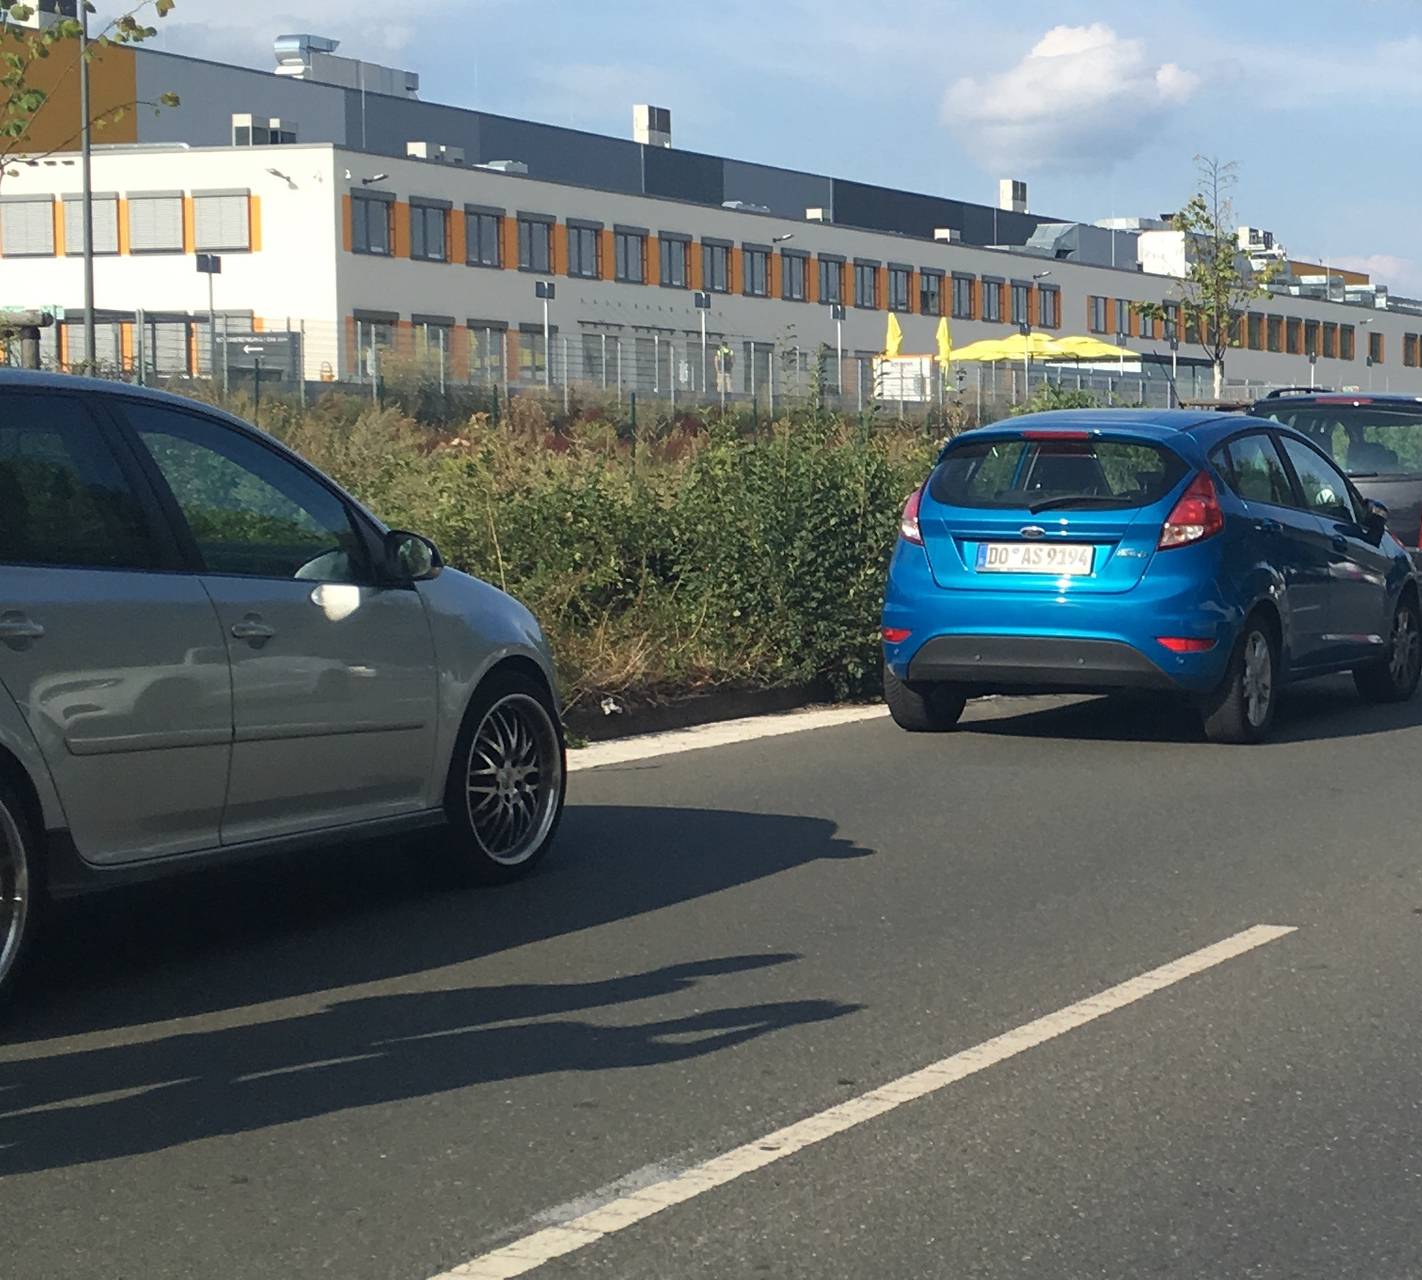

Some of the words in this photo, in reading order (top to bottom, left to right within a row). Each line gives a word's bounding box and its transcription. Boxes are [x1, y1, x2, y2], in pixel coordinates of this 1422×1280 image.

[988, 547, 1008, 564] DO
[1021, 547, 1042, 565] AS
[1047, 548, 1088, 566] 9194
